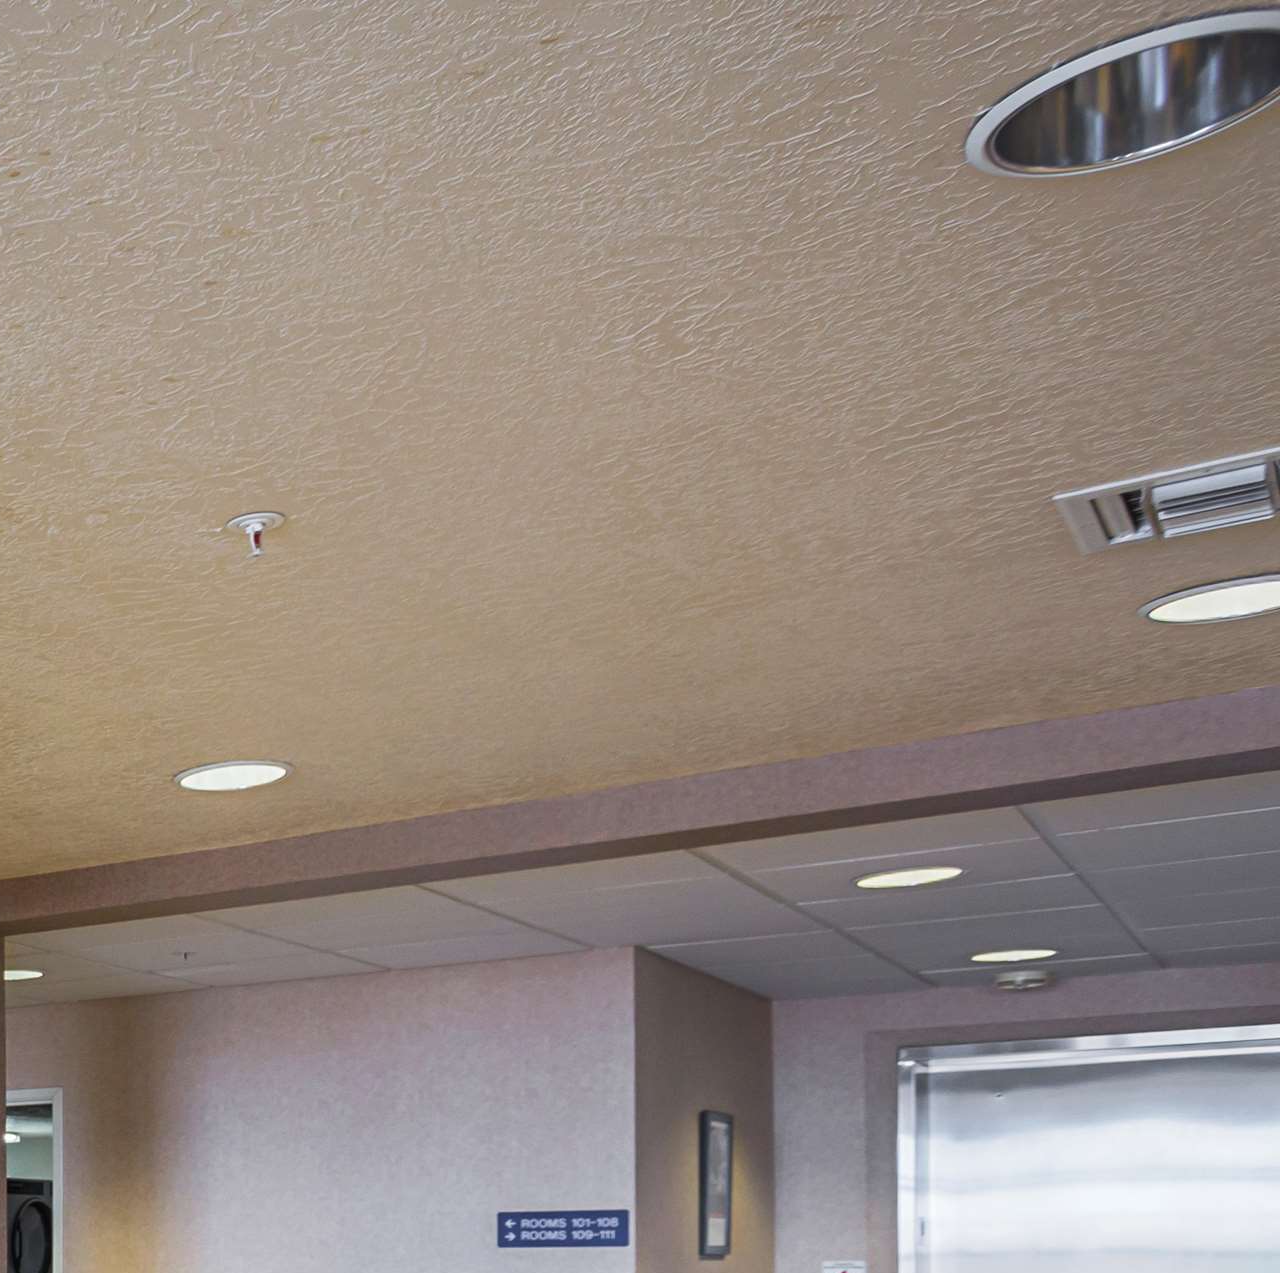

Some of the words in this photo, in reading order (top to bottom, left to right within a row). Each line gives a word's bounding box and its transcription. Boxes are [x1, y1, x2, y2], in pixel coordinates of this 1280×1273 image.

[521, 1218, 567, 1229] ROOMS
[572, 1217, 619, 1228] 101-108
[521, 1230, 567, 1240] ROOMS
[572, 1230, 616, 1240] 109-111
